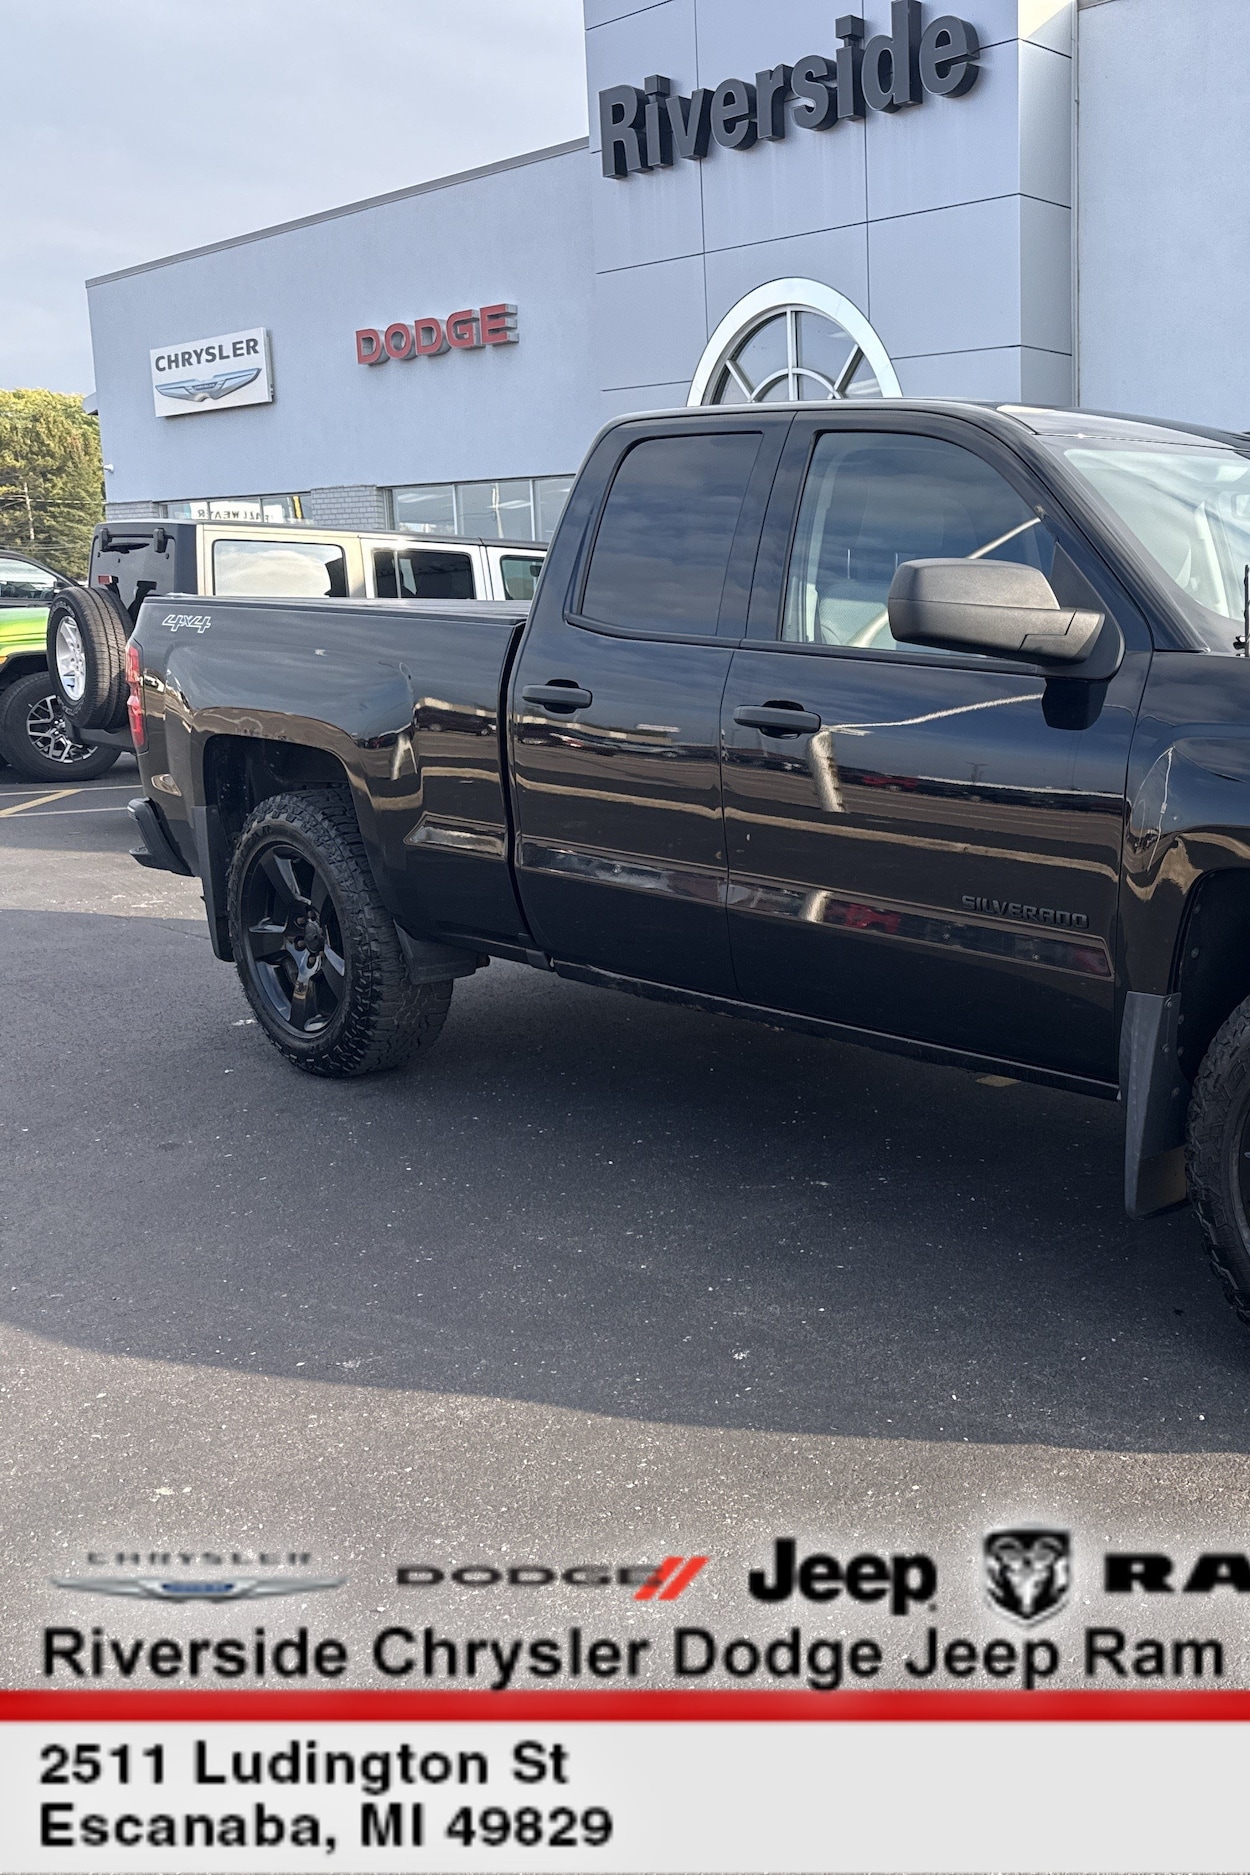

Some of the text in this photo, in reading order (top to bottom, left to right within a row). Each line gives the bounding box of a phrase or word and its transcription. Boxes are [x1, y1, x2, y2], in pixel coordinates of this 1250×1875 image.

[599, 0, 981, 179] Riverside
[155, 338, 260, 372] CHRYSLER
[355, 303, 520, 366] DODGE
[961, 895, 1089, 929] SILVERADO
